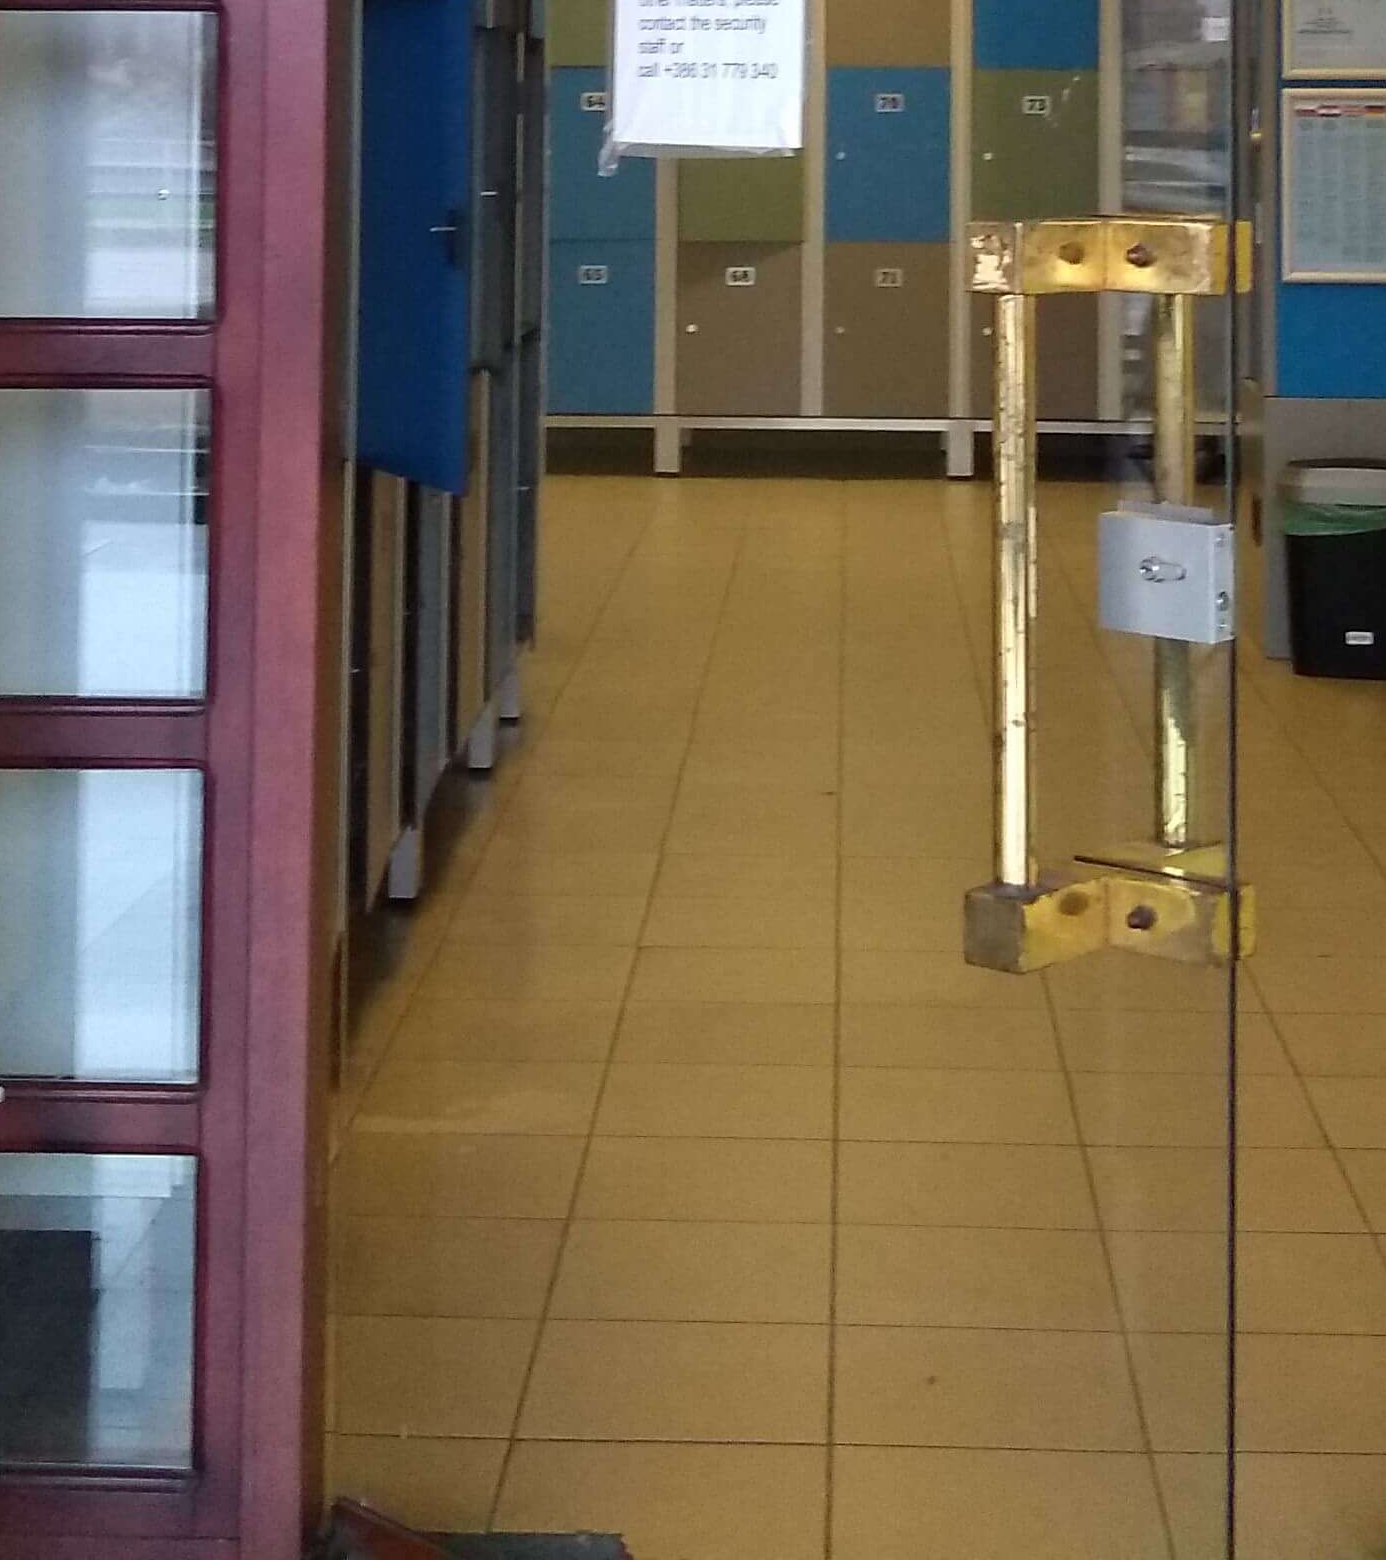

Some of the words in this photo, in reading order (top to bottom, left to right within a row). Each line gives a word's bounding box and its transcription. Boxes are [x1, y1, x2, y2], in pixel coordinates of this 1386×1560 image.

[639, 16, 686, 31] contact
[690, 16, 711, 31] the
[715, 16, 767, 34] security
[638, 38, 666, 54] staff
[670, 41, 685, 54] or
[638, 62, 659, 78] call
[1027, 98, 1046, 112] 73
